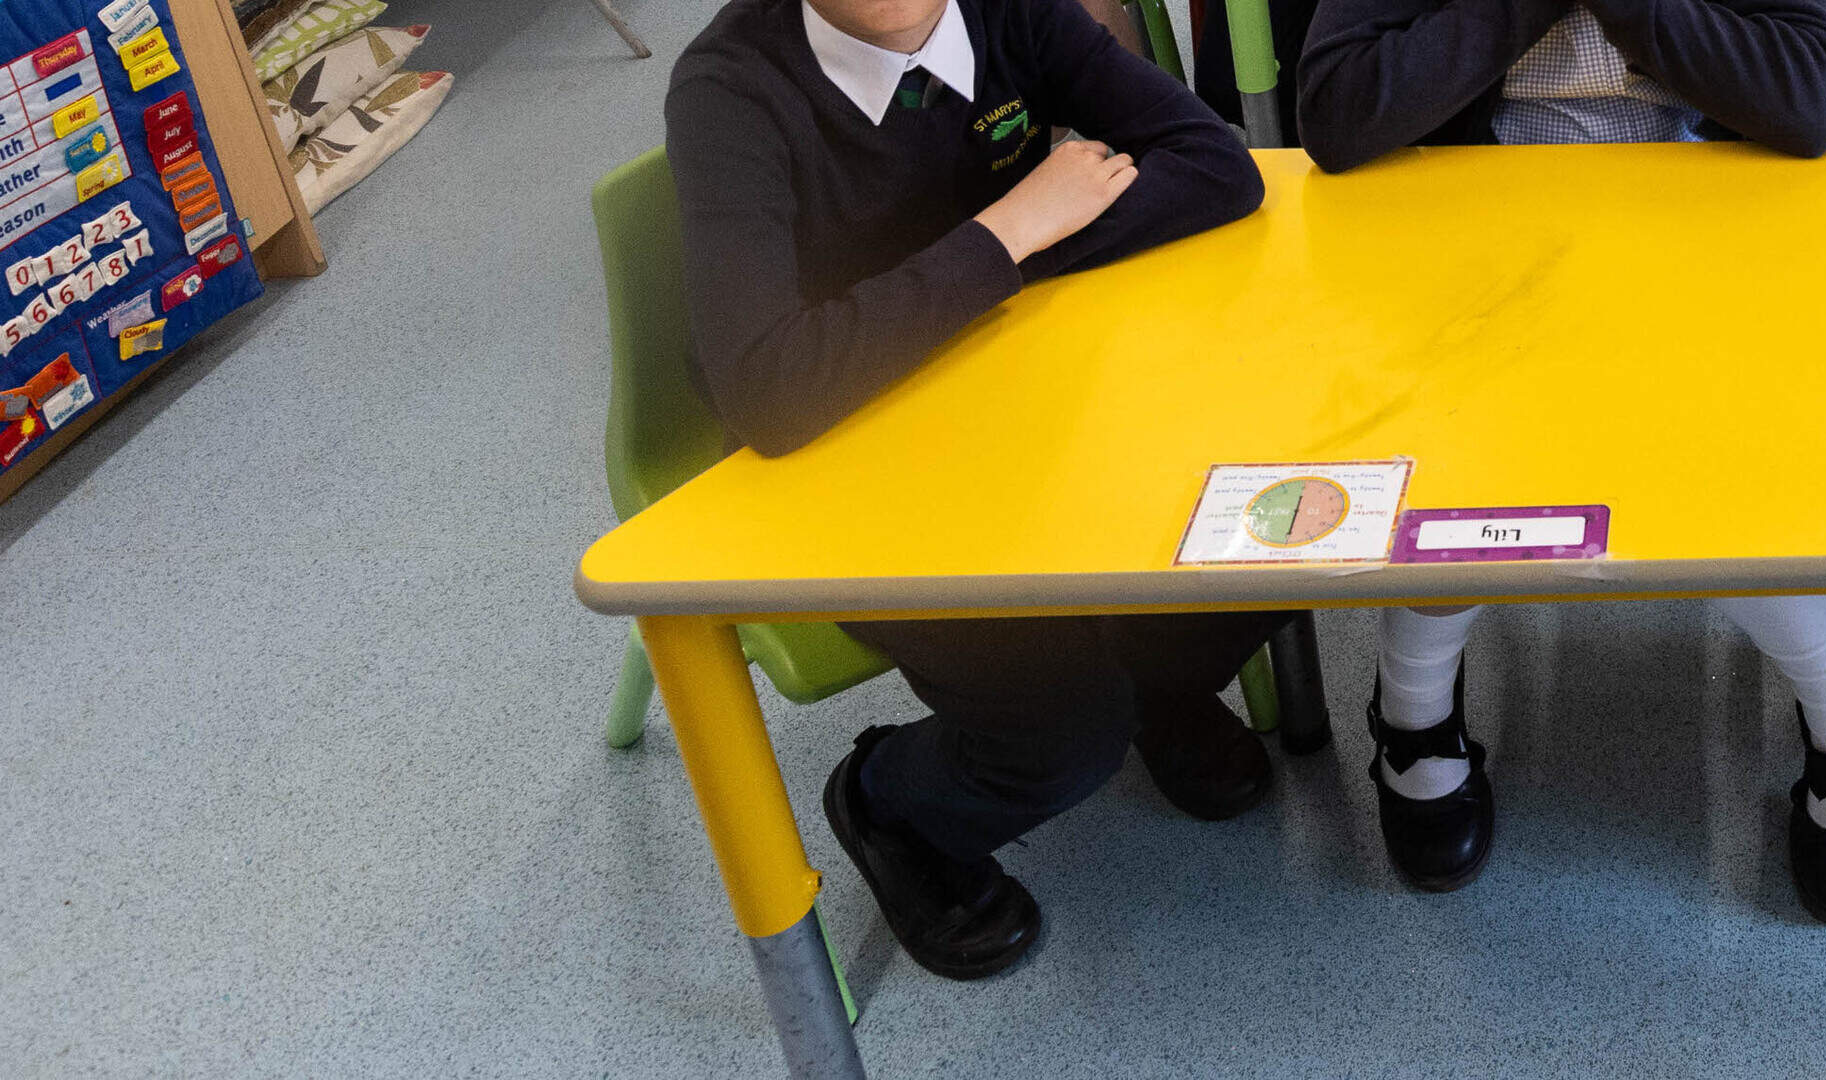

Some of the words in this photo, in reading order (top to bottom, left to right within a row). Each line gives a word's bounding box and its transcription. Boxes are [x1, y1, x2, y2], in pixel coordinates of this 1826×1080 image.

[117, 13, 152, 46] February
[38, 44, 78, 69] Thursday
[131, 38, 159, 59] March
[144, 61, 165, 77] April
[68, 108, 87, 124] May
[158, 103, 179, 120] June
[973, 119, 988, 132] ST
[984, 99, 1021, 123] MARY'S
[164, 125, 182, 141] July
[163, 140, 193, 164] August
[82, 180, 105, 198] Spring
[16, 265, 29, 286] 0
[47, 256, 54, 276] 1
[67, 243, 83, 265] 2
[92, 223, 106, 245] 2
[115, 209, 131, 231] 3
[200, 248, 221, 264] Foggy
[6, 323, 21, 347] 5
[32, 303, 48, 324] 6
[59, 283, 75, 306] 6
[82, 270, 95, 292] 7
[109, 257, 123, 278] 8
[135, 239, 142, 257] 1
[123, 325, 150, 340] Cloudy
[1481, 524, 1522, 543] Lily
